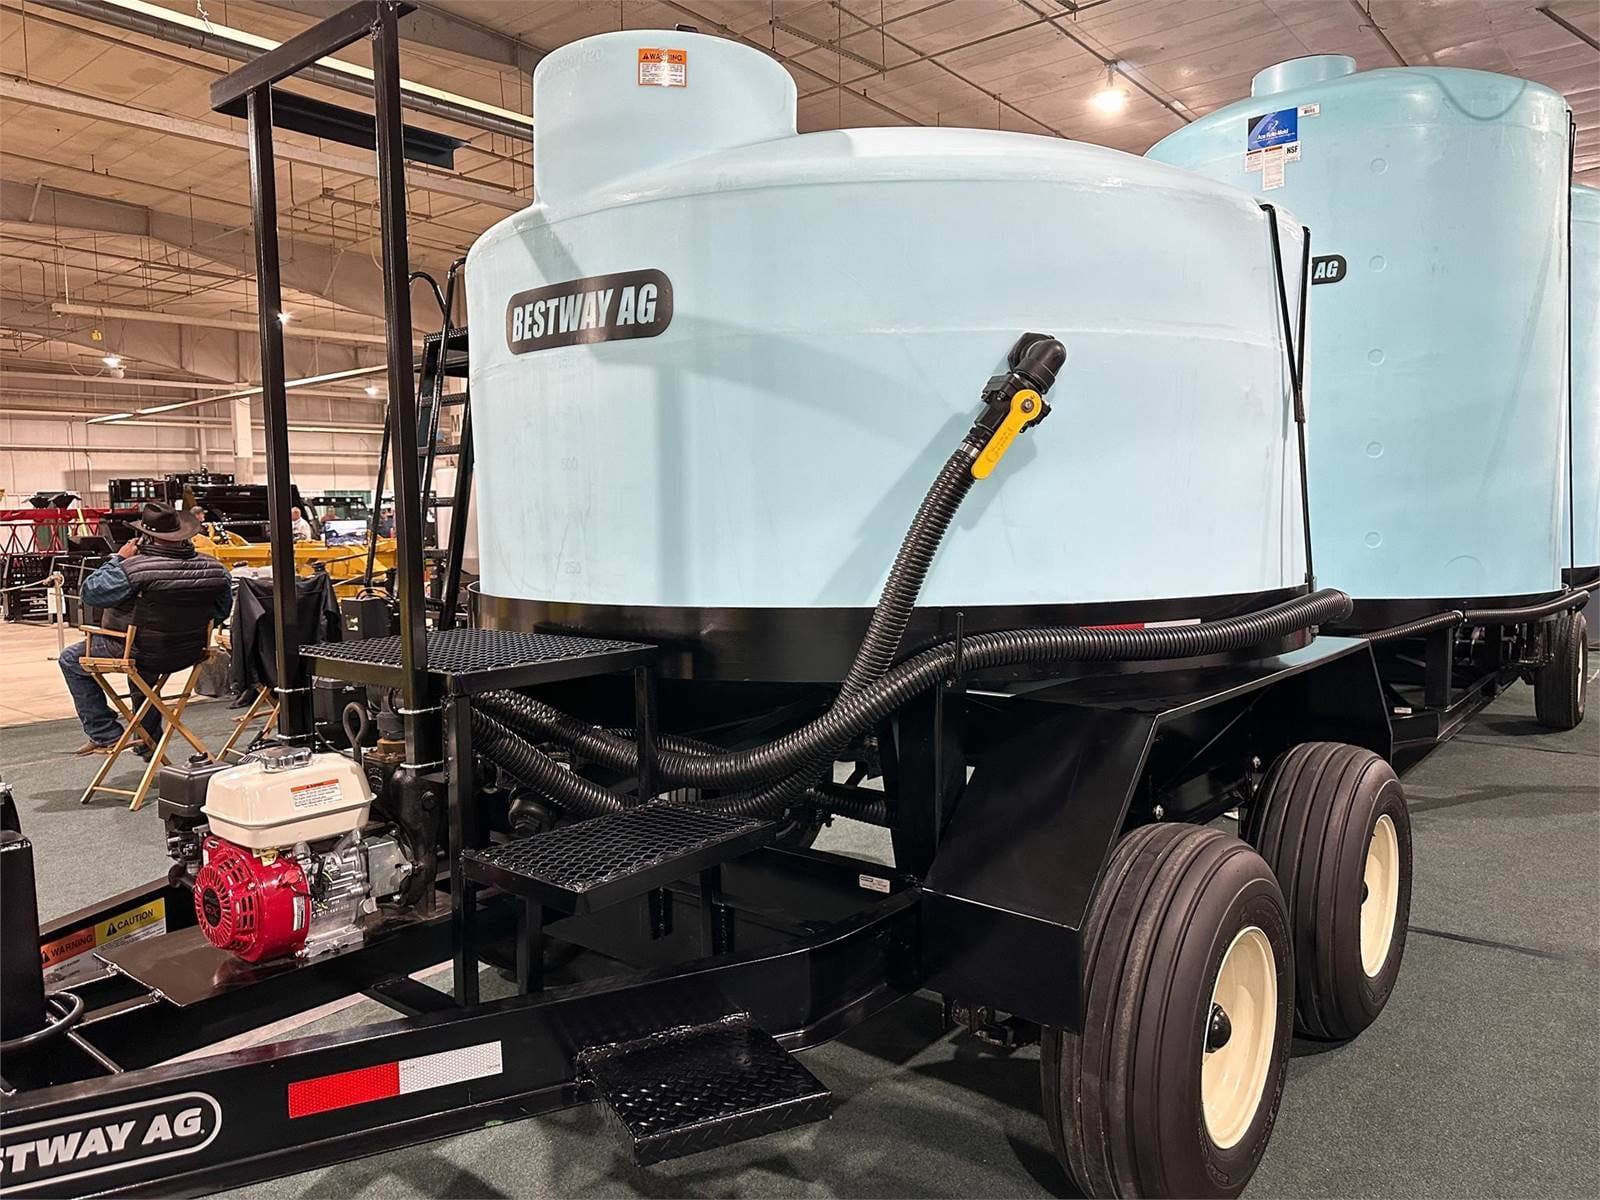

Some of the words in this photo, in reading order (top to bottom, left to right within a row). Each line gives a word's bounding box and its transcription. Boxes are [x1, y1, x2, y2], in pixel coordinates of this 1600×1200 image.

[1286, 145, 1299, 155] NSF
[1313, 260, 1339, 279] AG
[511, 288, 614, 343] BESTWAY
[615, 283, 658, 326] AG
[117, 908, 154, 930] CAUTION
[50, 934, 93, 957] WARNING
[0, 1120, 136, 1175] TWAY
